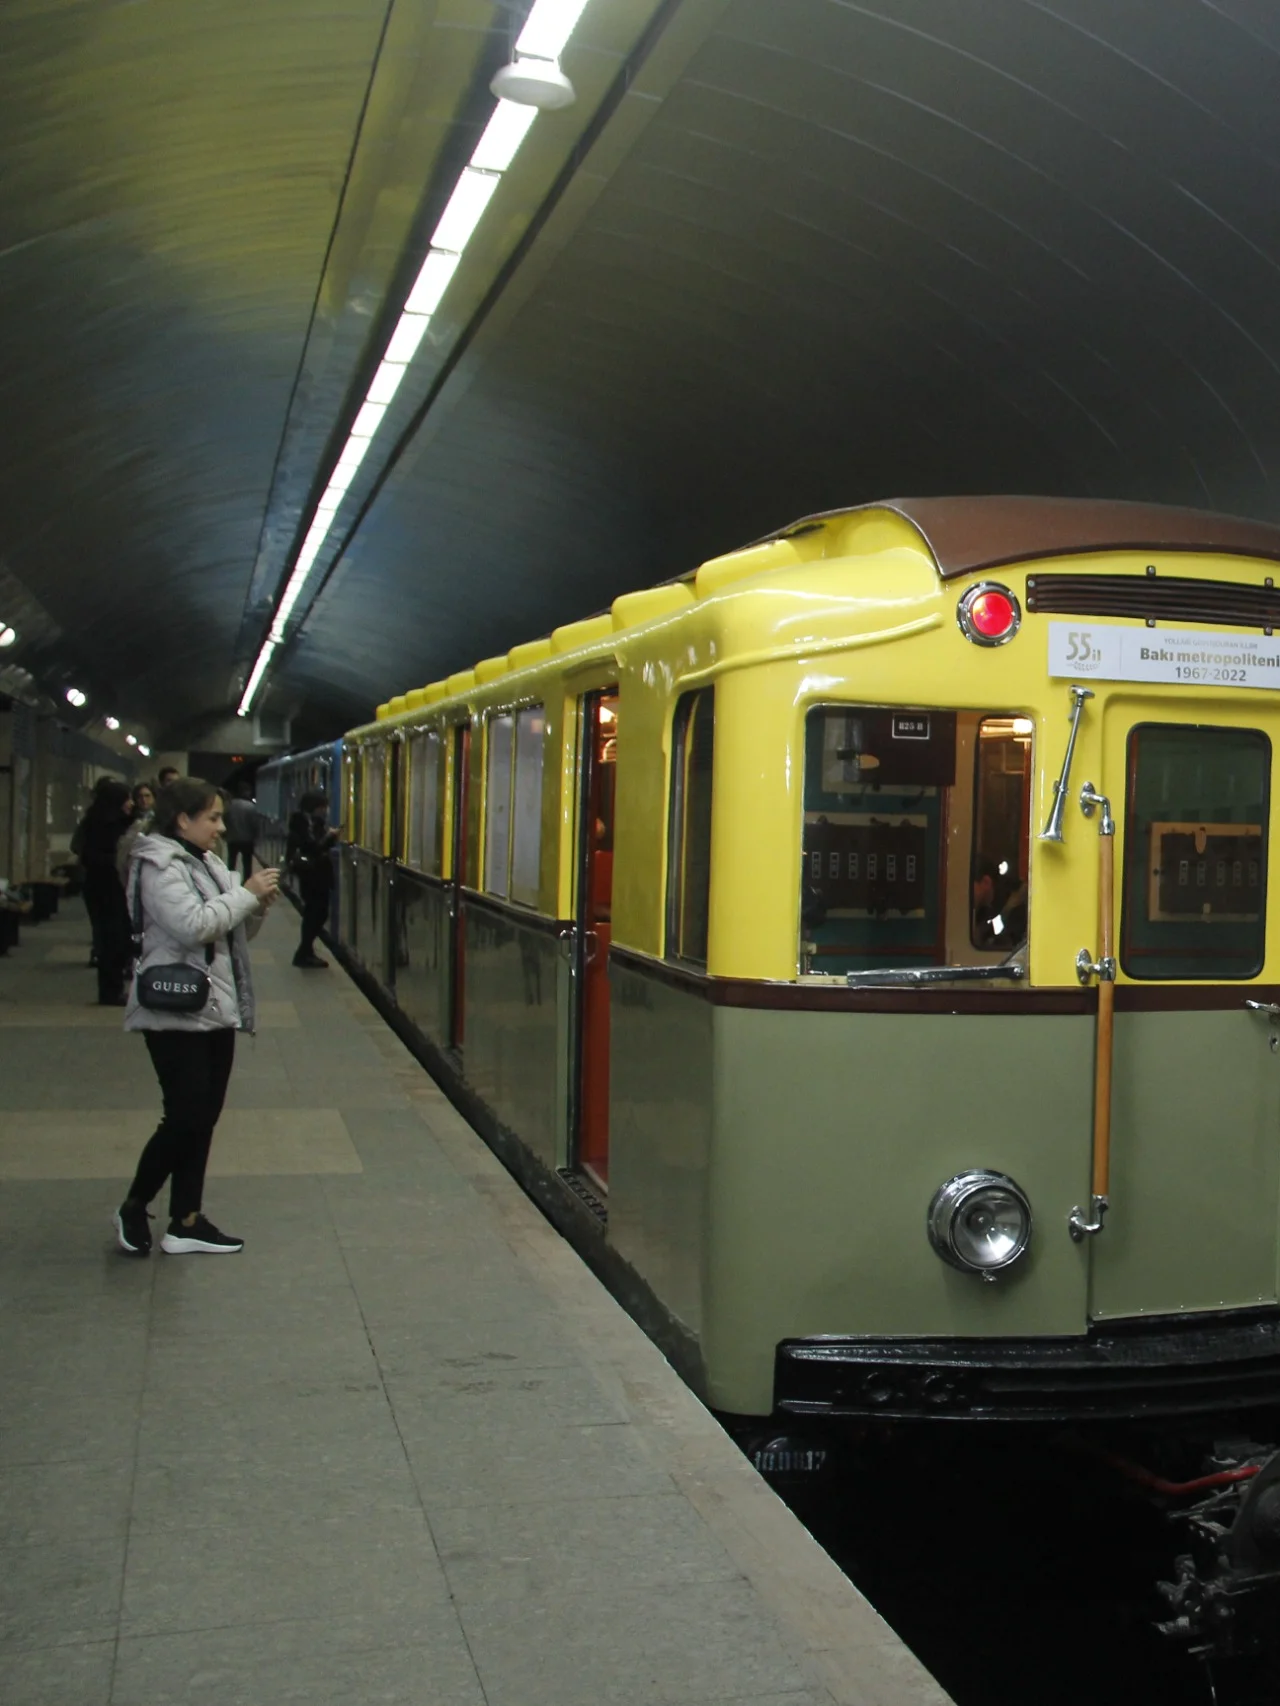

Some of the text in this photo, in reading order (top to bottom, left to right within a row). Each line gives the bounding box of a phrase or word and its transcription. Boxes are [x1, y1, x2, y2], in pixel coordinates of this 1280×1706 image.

[1140, 647, 1280, 668] Bakı metropoliteni
[1175, 666, 1247, 682] 1967-2022
[152, 981, 198, 993] GUESS
